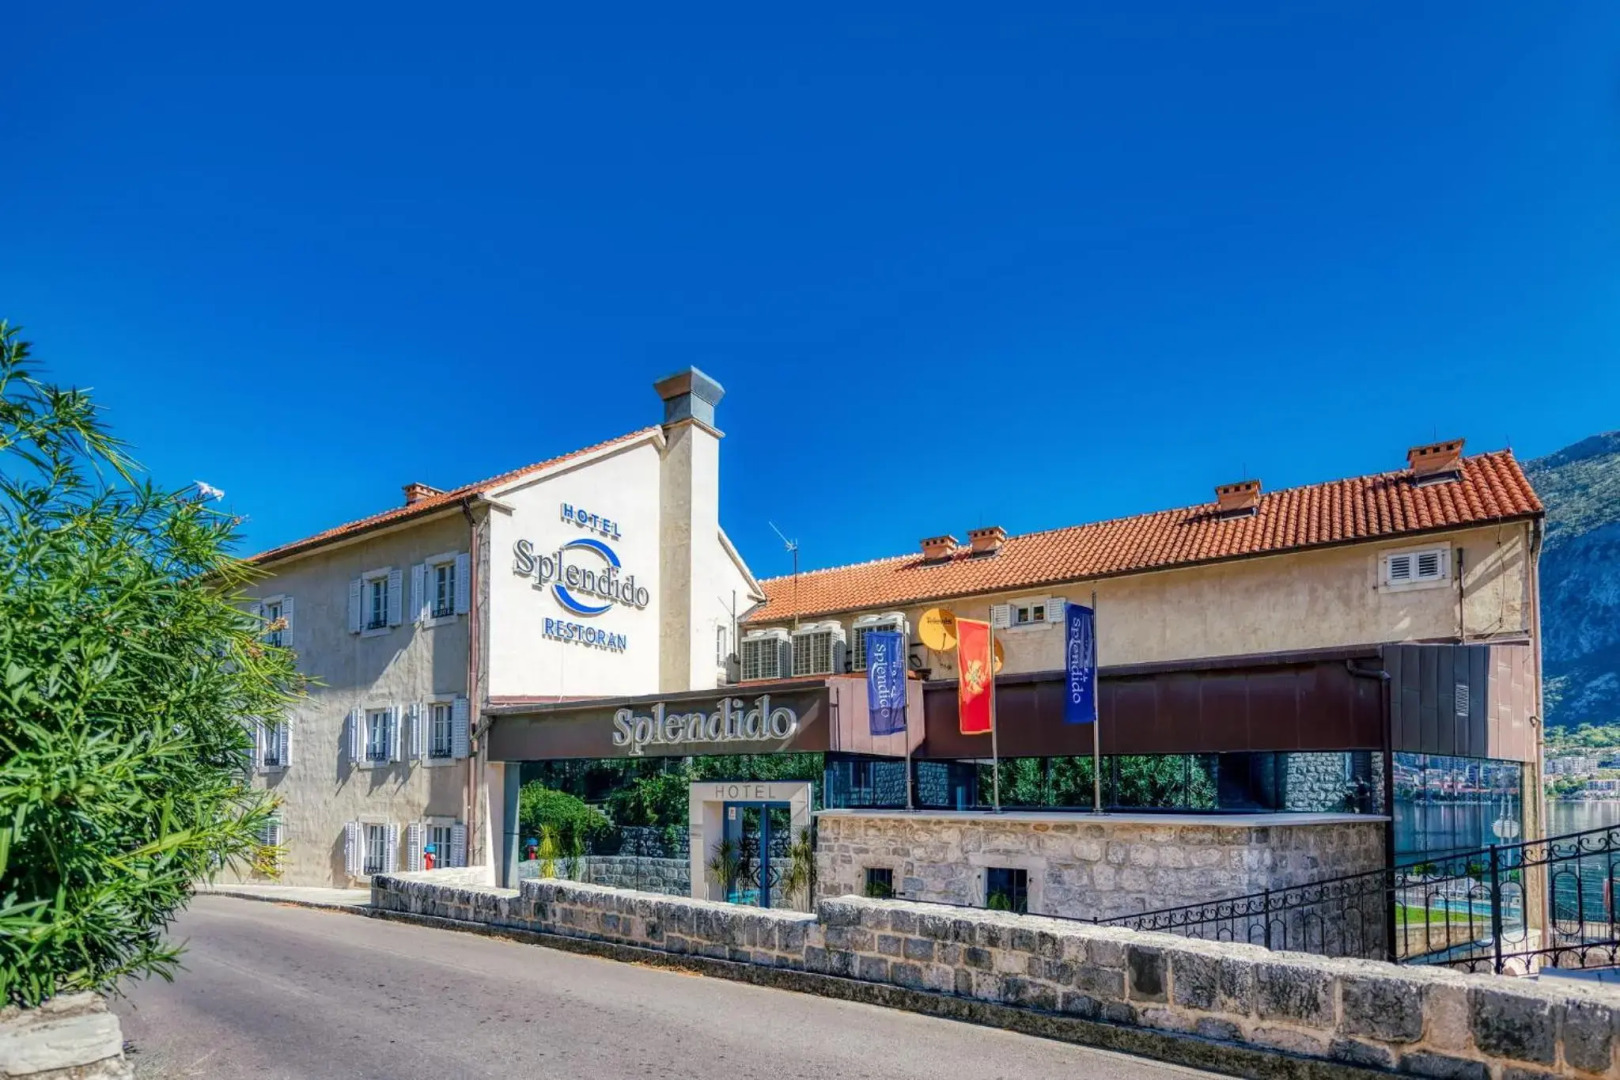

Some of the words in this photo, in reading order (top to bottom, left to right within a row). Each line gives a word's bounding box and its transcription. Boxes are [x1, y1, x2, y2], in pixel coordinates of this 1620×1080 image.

[562, 502, 622, 538] HOTEL
[513, 538, 649, 608] Splendido
[543, 616, 628, 651] RESTORAN
[1070, 616, 1084, 704] Splendido
[874, 643, 890, 718] Splendido
[612, 694, 798, 757] Splendido
[715, 784, 776, 799] HOTEL
